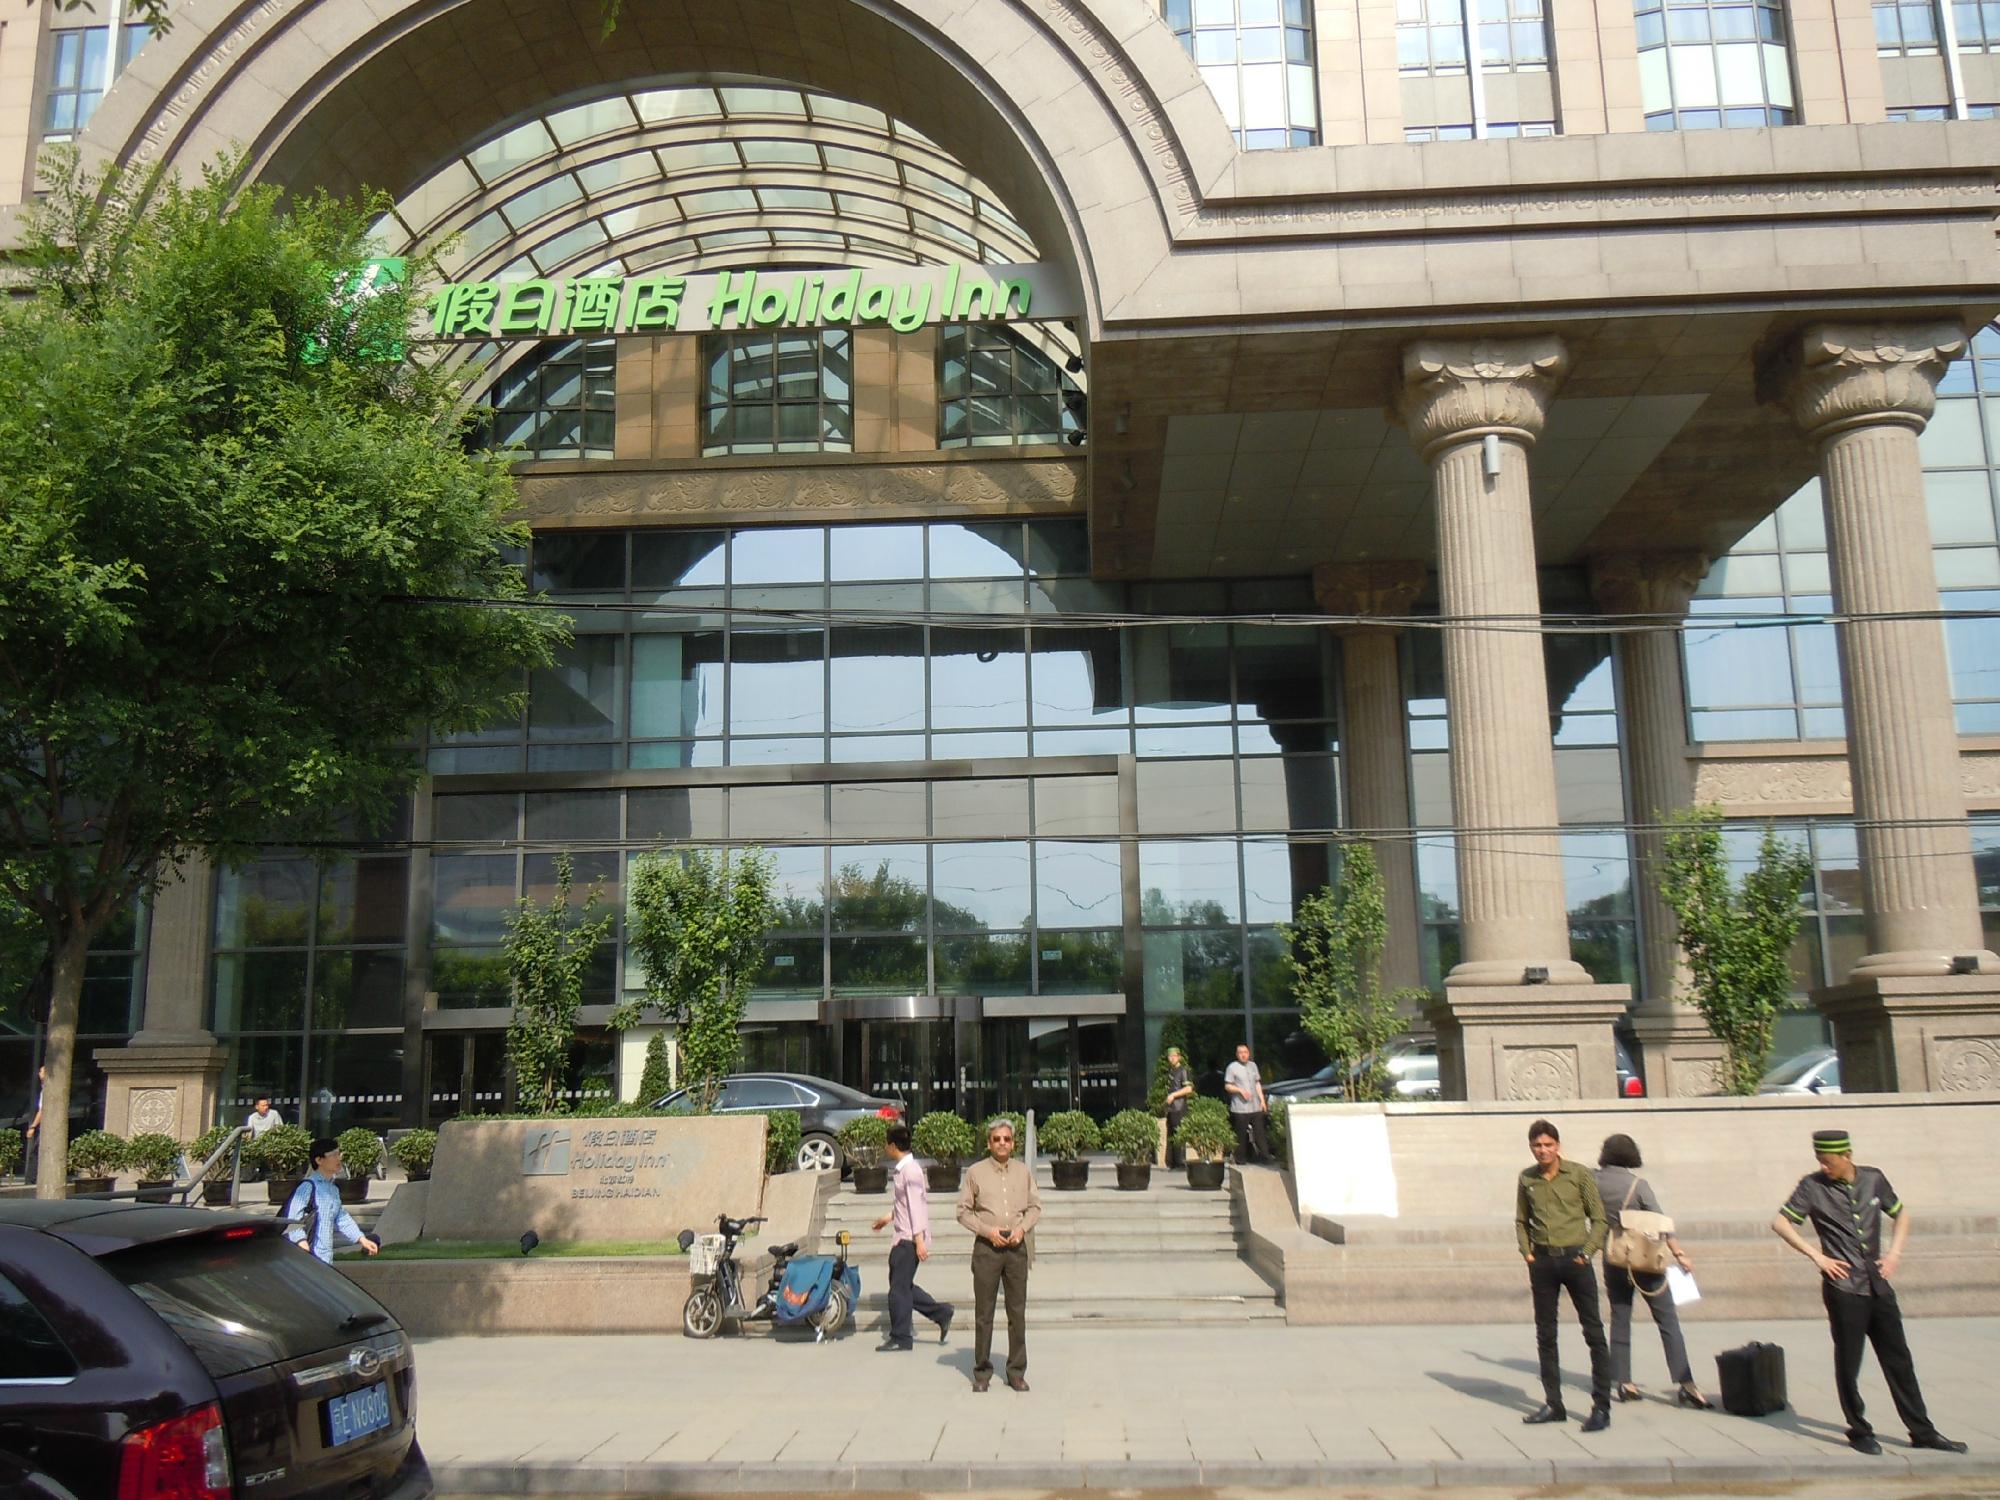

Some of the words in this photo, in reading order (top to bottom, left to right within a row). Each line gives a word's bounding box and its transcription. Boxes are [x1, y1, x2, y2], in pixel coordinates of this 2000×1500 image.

[427, 275, 687, 334] 假日酒店
[707, 270, 932, 333] Holiday
[940, 264, 1031, 318] Inn
[582, 1129, 658, 1147] 假日酒店
[570, 1151, 637, 1172] Holiday
[571, 1188, 614, 1199] BEIJING
[615, 1187, 660, 1198] HAIDIAN
